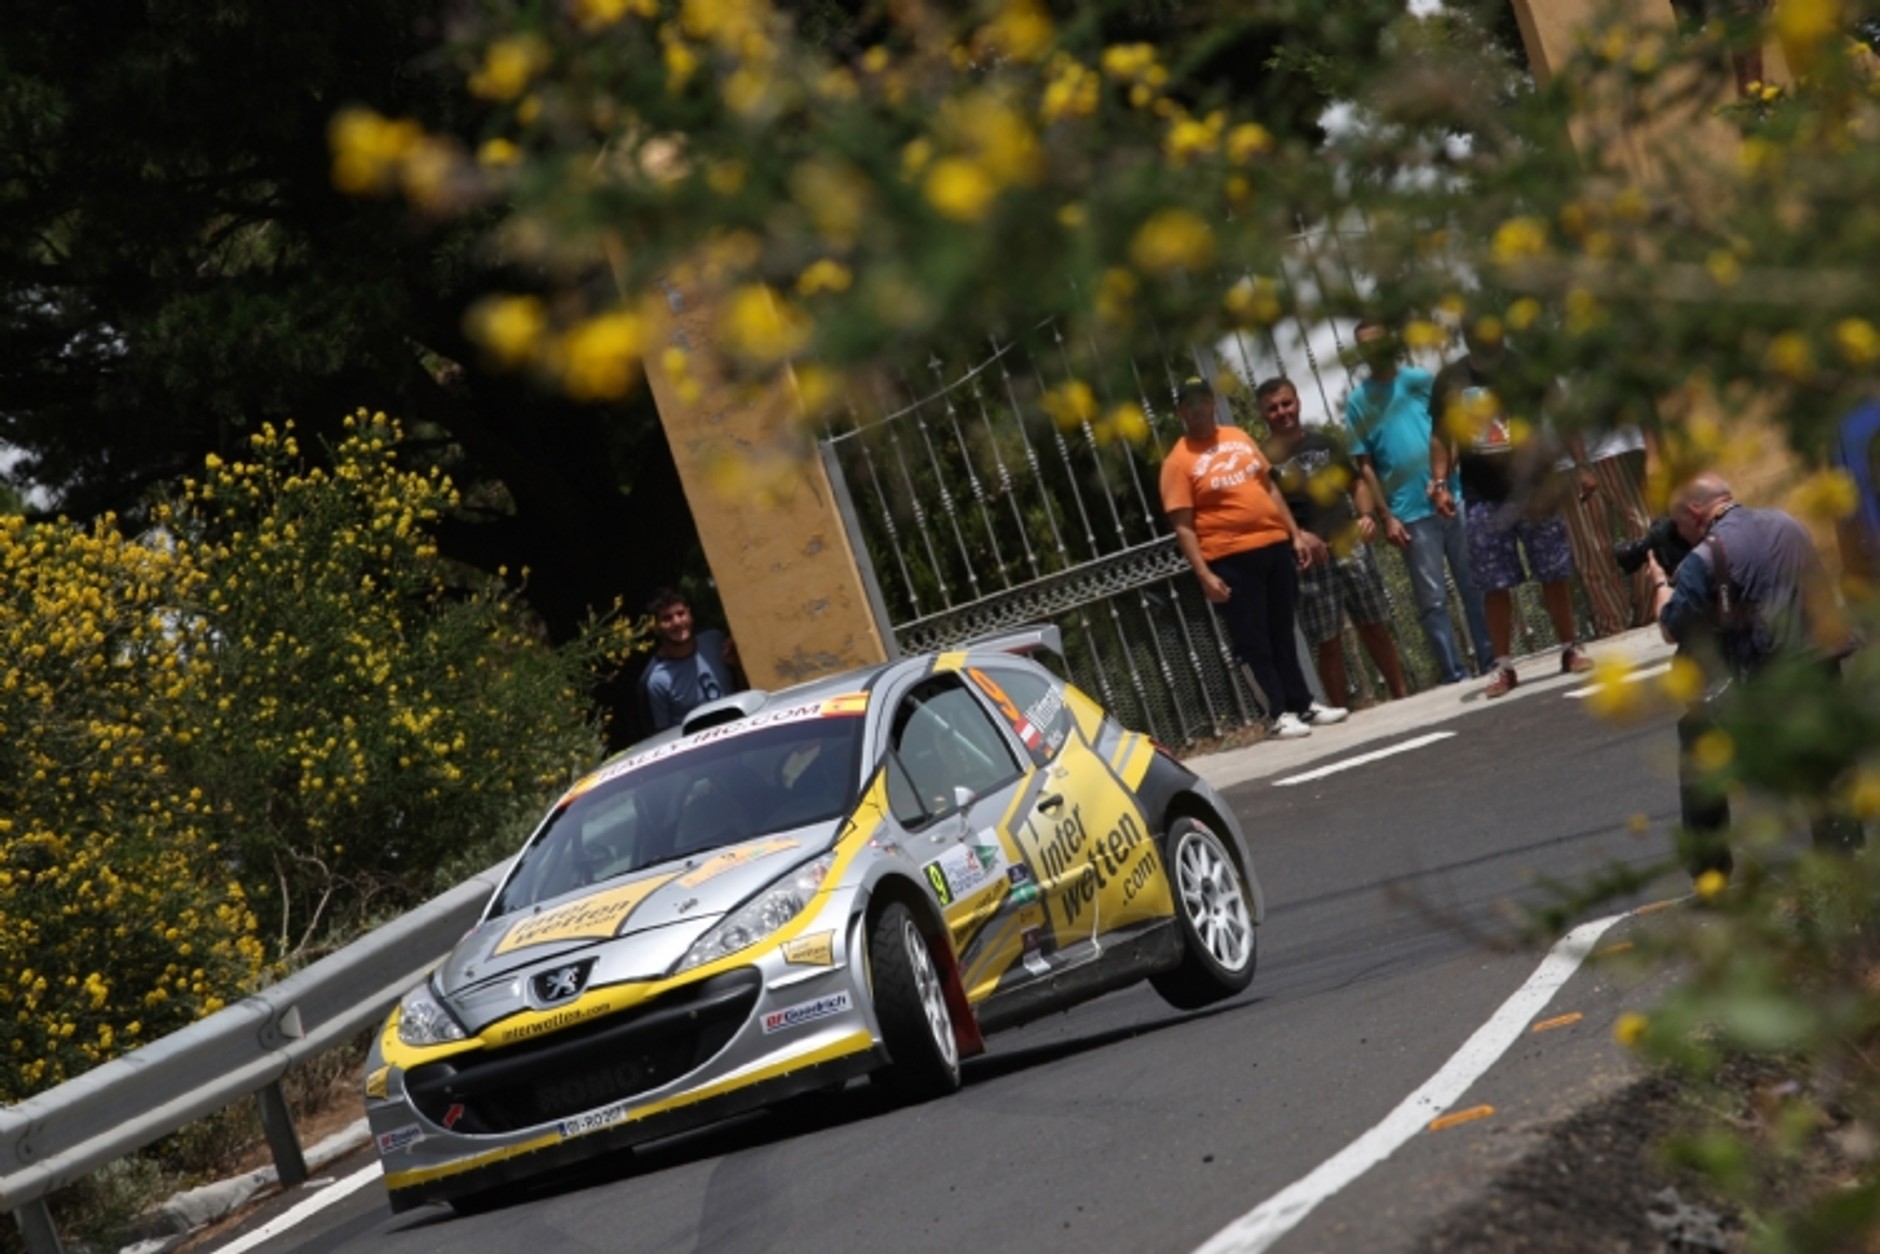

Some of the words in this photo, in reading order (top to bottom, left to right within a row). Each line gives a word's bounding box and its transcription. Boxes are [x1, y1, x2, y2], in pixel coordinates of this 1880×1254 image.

[1061, 811, 1142, 927] wetten
[1122, 851, 1158, 906] .com
[501, 1002, 612, 1041] interwetten.com
[766, 995, 847, 1029] BFGoodrich
